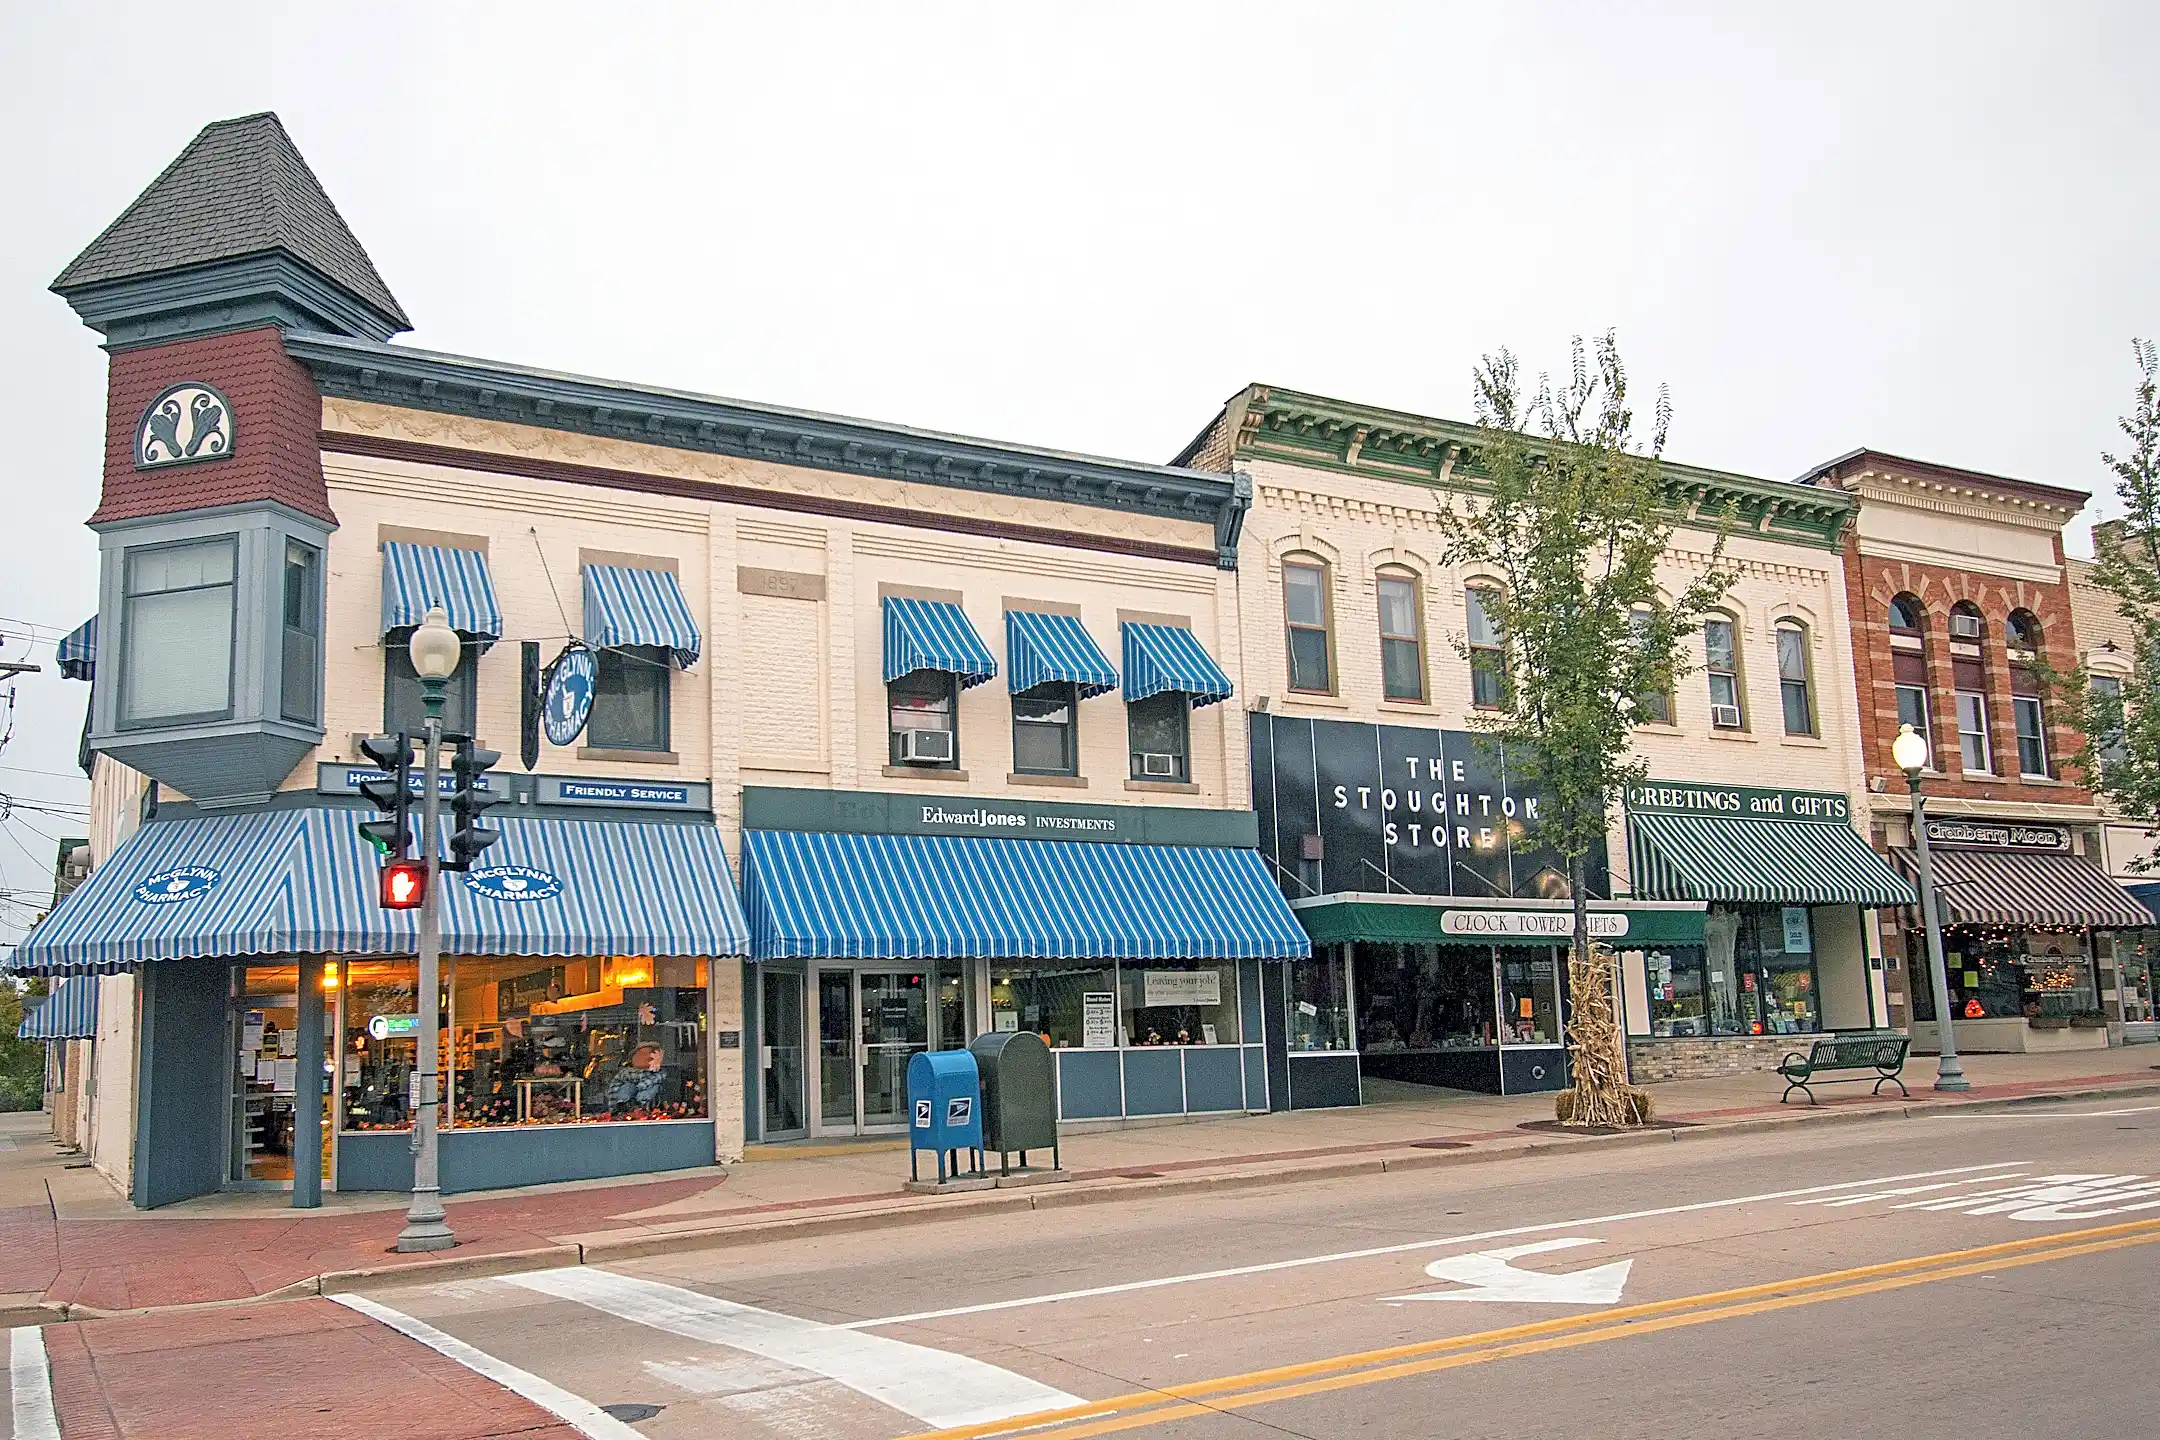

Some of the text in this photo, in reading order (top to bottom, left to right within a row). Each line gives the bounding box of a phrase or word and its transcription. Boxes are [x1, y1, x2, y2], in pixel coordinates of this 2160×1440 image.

[1406, 756, 1465, 781] THE
[565, 784, 683, 800] FRIENDLY SERVICE
[1333, 785, 1539, 819] STOUGHTON
[1750, 793, 1784, 813] and
[1791, 796, 1846, 818] GIFTS
[1035, 815, 1116, 832] INVESTMENTS
[1926, 822, 2057, 846] Cranberry Moon
[1385, 822, 1496, 849] STORE
[135, 881, 212, 903] PHARMACY
[466, 880, 559, 899] PHARMACY
[1453, 914, 1617, 933] CLOCK TOWER IFTS
[1147, 975, 1178, 988] Leaving
[1179, 976, 1197, 988] your
